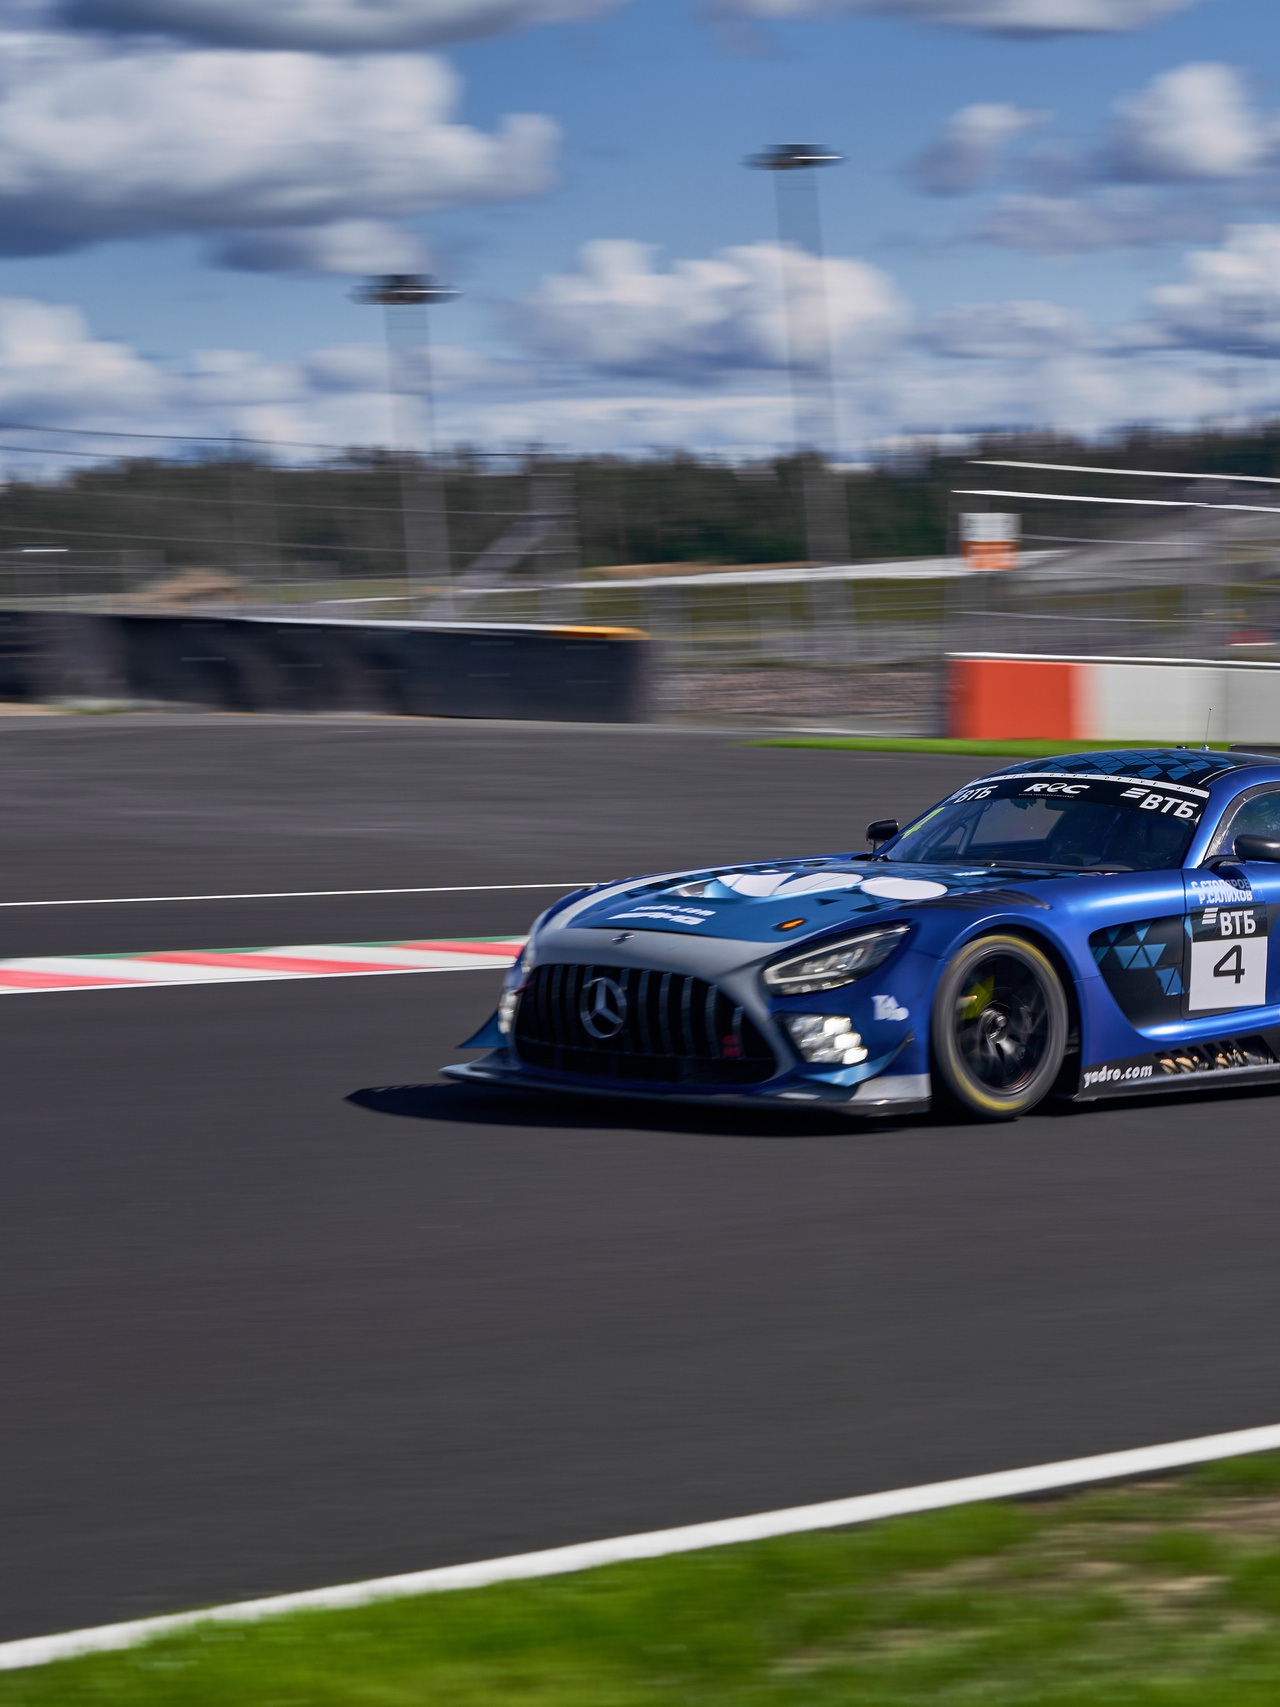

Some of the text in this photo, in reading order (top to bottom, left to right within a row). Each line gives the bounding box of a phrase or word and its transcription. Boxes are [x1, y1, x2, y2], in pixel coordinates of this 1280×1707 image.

[1139, 793, 1200, 819] ВТБ
[1219, 909, 1257, 937] ВТБ
[1213, 944, 1246, 985] 4
[1083, 1064, 1154, 1089] yadro.com
